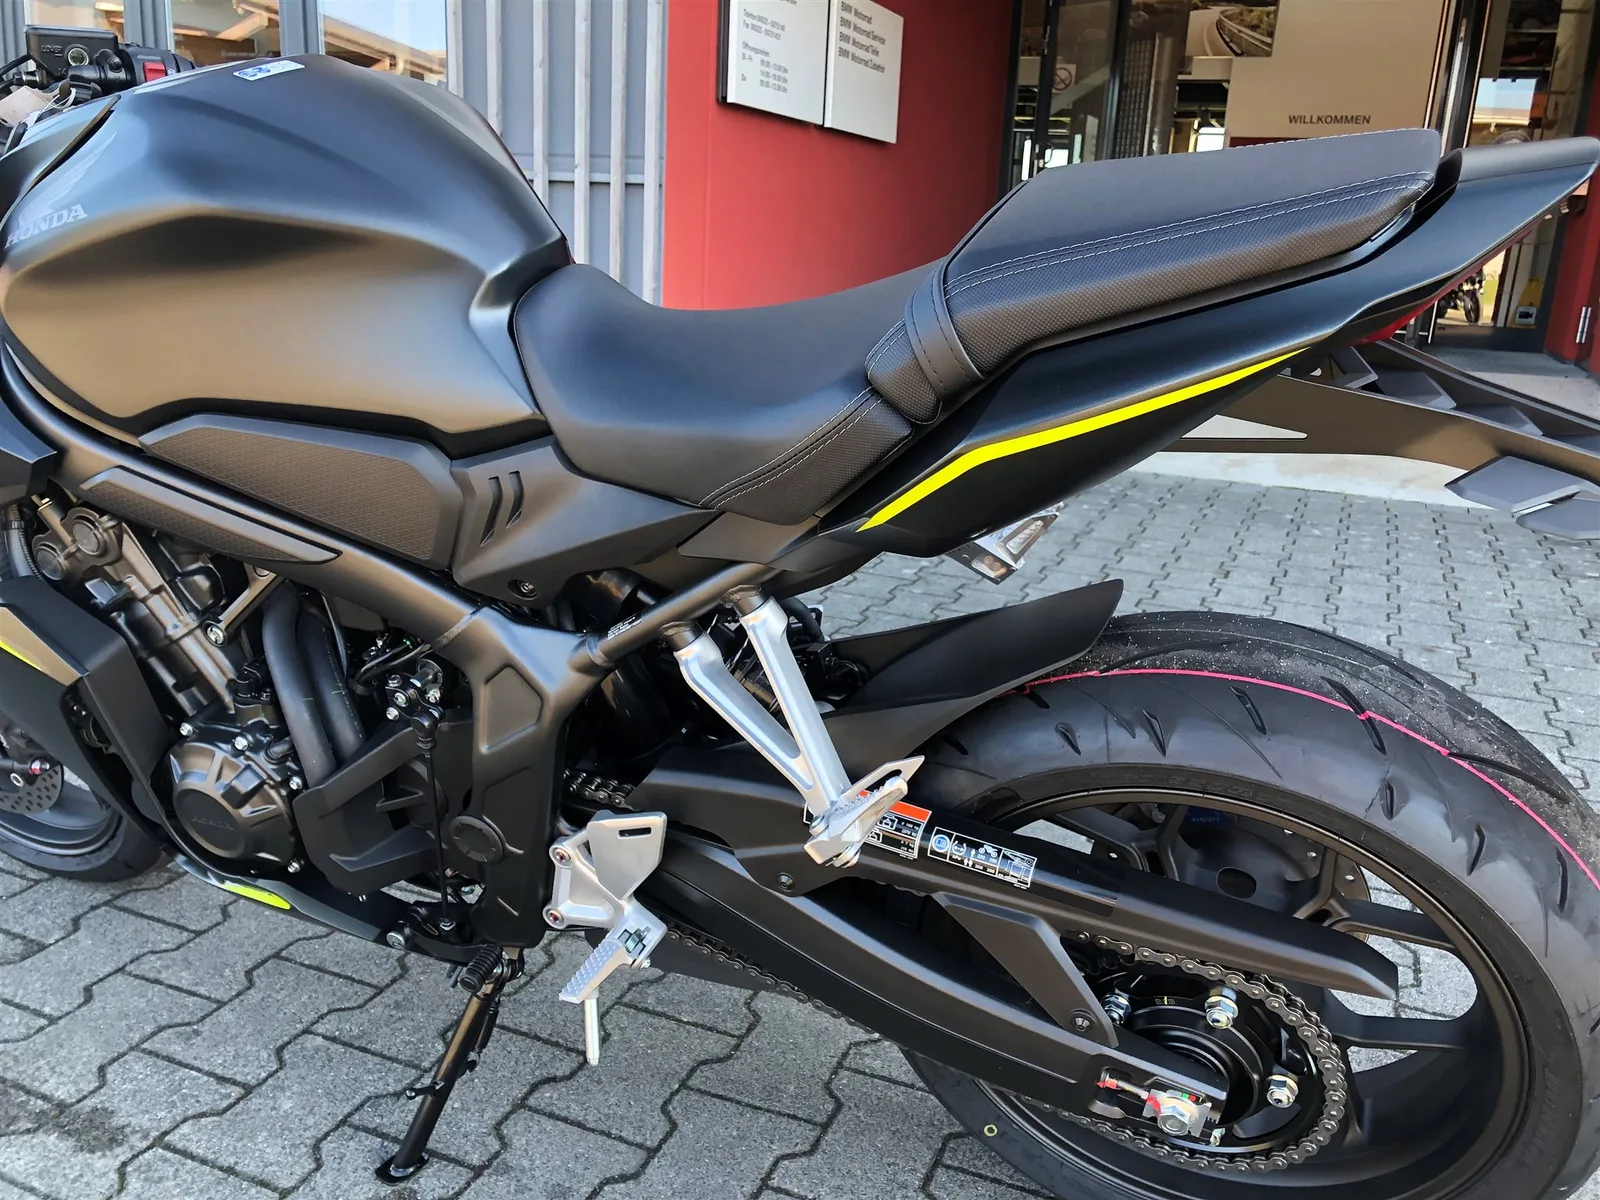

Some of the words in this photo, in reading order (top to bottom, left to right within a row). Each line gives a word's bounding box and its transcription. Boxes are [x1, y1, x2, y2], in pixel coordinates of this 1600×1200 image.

[841, 1, 852, 14] BMW
[854, 7, 872, 25] Motorrad
[840, 16, 851, 29] BMW
[853, 22, 871, 39] Motorrad
[839, 31, 851, 44] BMW
[852, 37, 870, 53] Motorrad
[838, 46, 850, 59] BMW
[851, 51, 869, 67] Motorrad
[1288, 114, 1371, 125] WILLKOMMEN
[4, 204, 87, 249] HONDA
